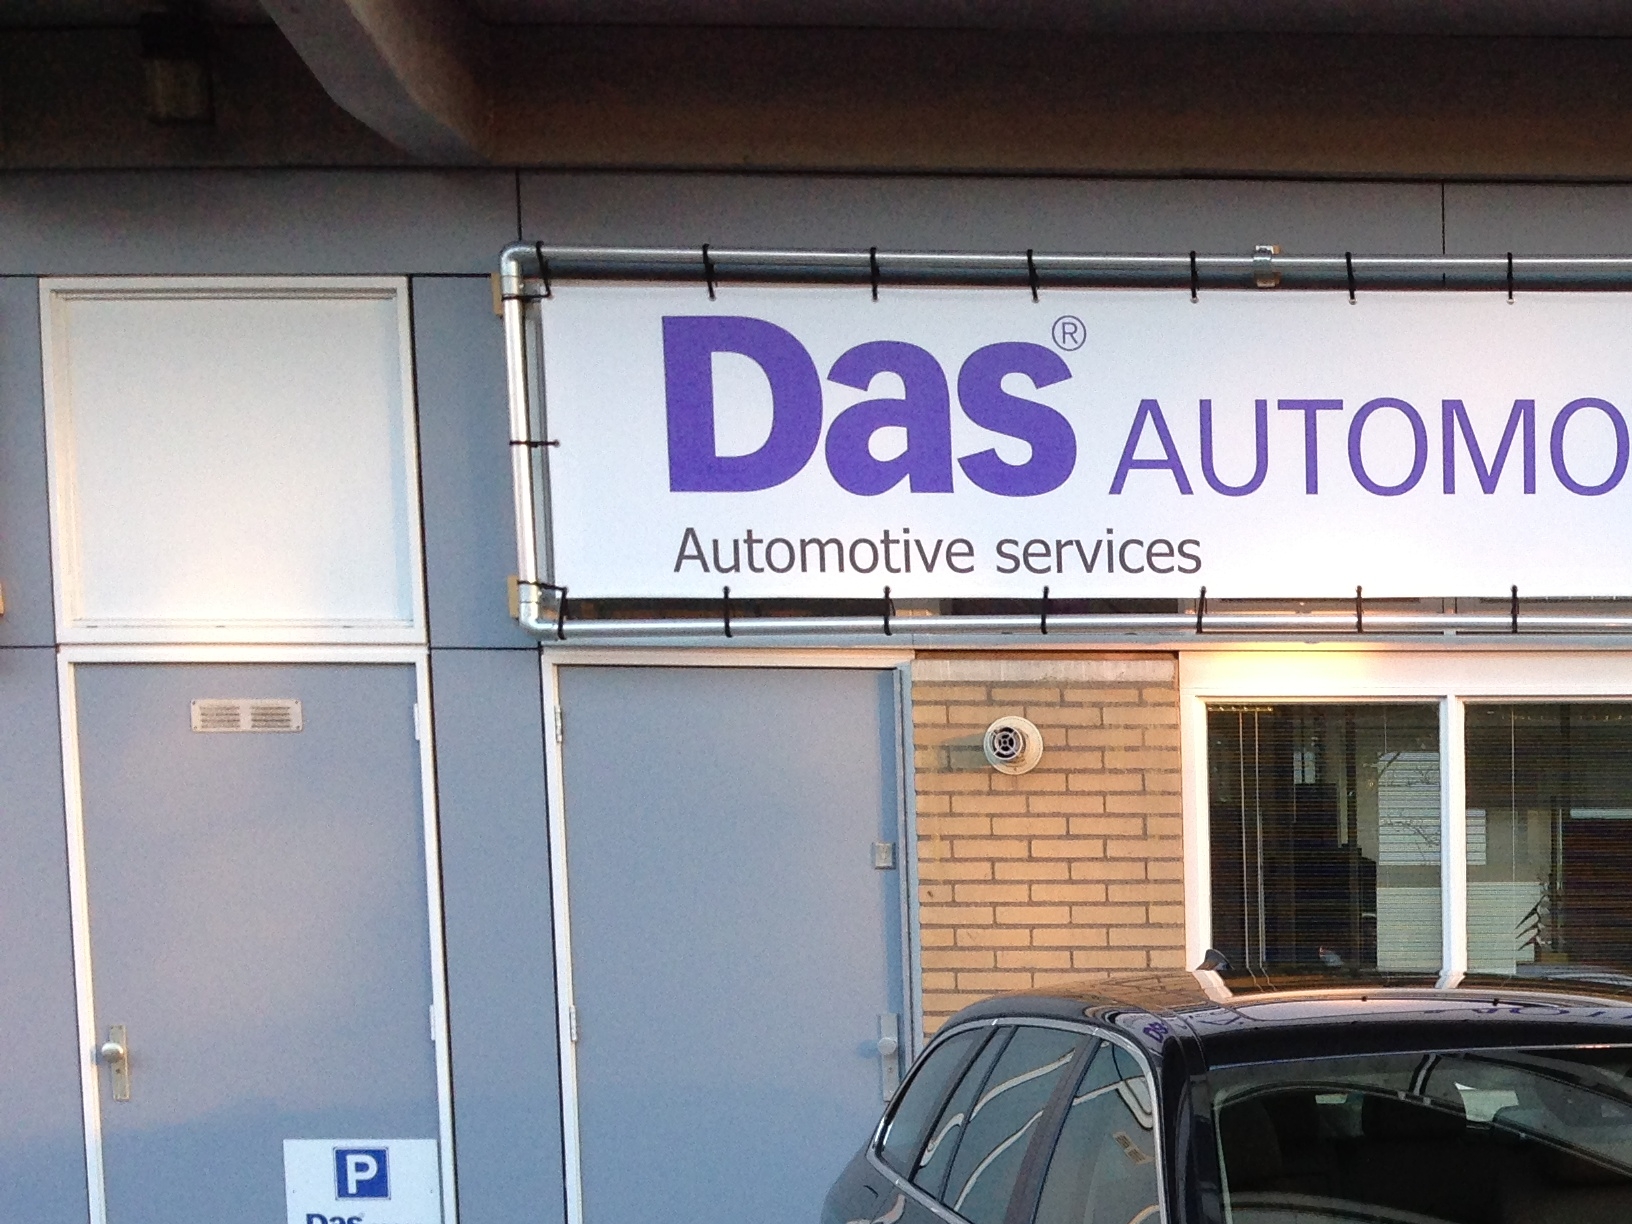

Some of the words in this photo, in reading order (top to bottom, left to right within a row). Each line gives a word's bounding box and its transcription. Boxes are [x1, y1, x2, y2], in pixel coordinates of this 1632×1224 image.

[661, 314, 1078, 498] Das
[673, 526, 976, 575] Automotive
[995, 528, 1203, 576] services
[345, 1153, 379, 1195] P
